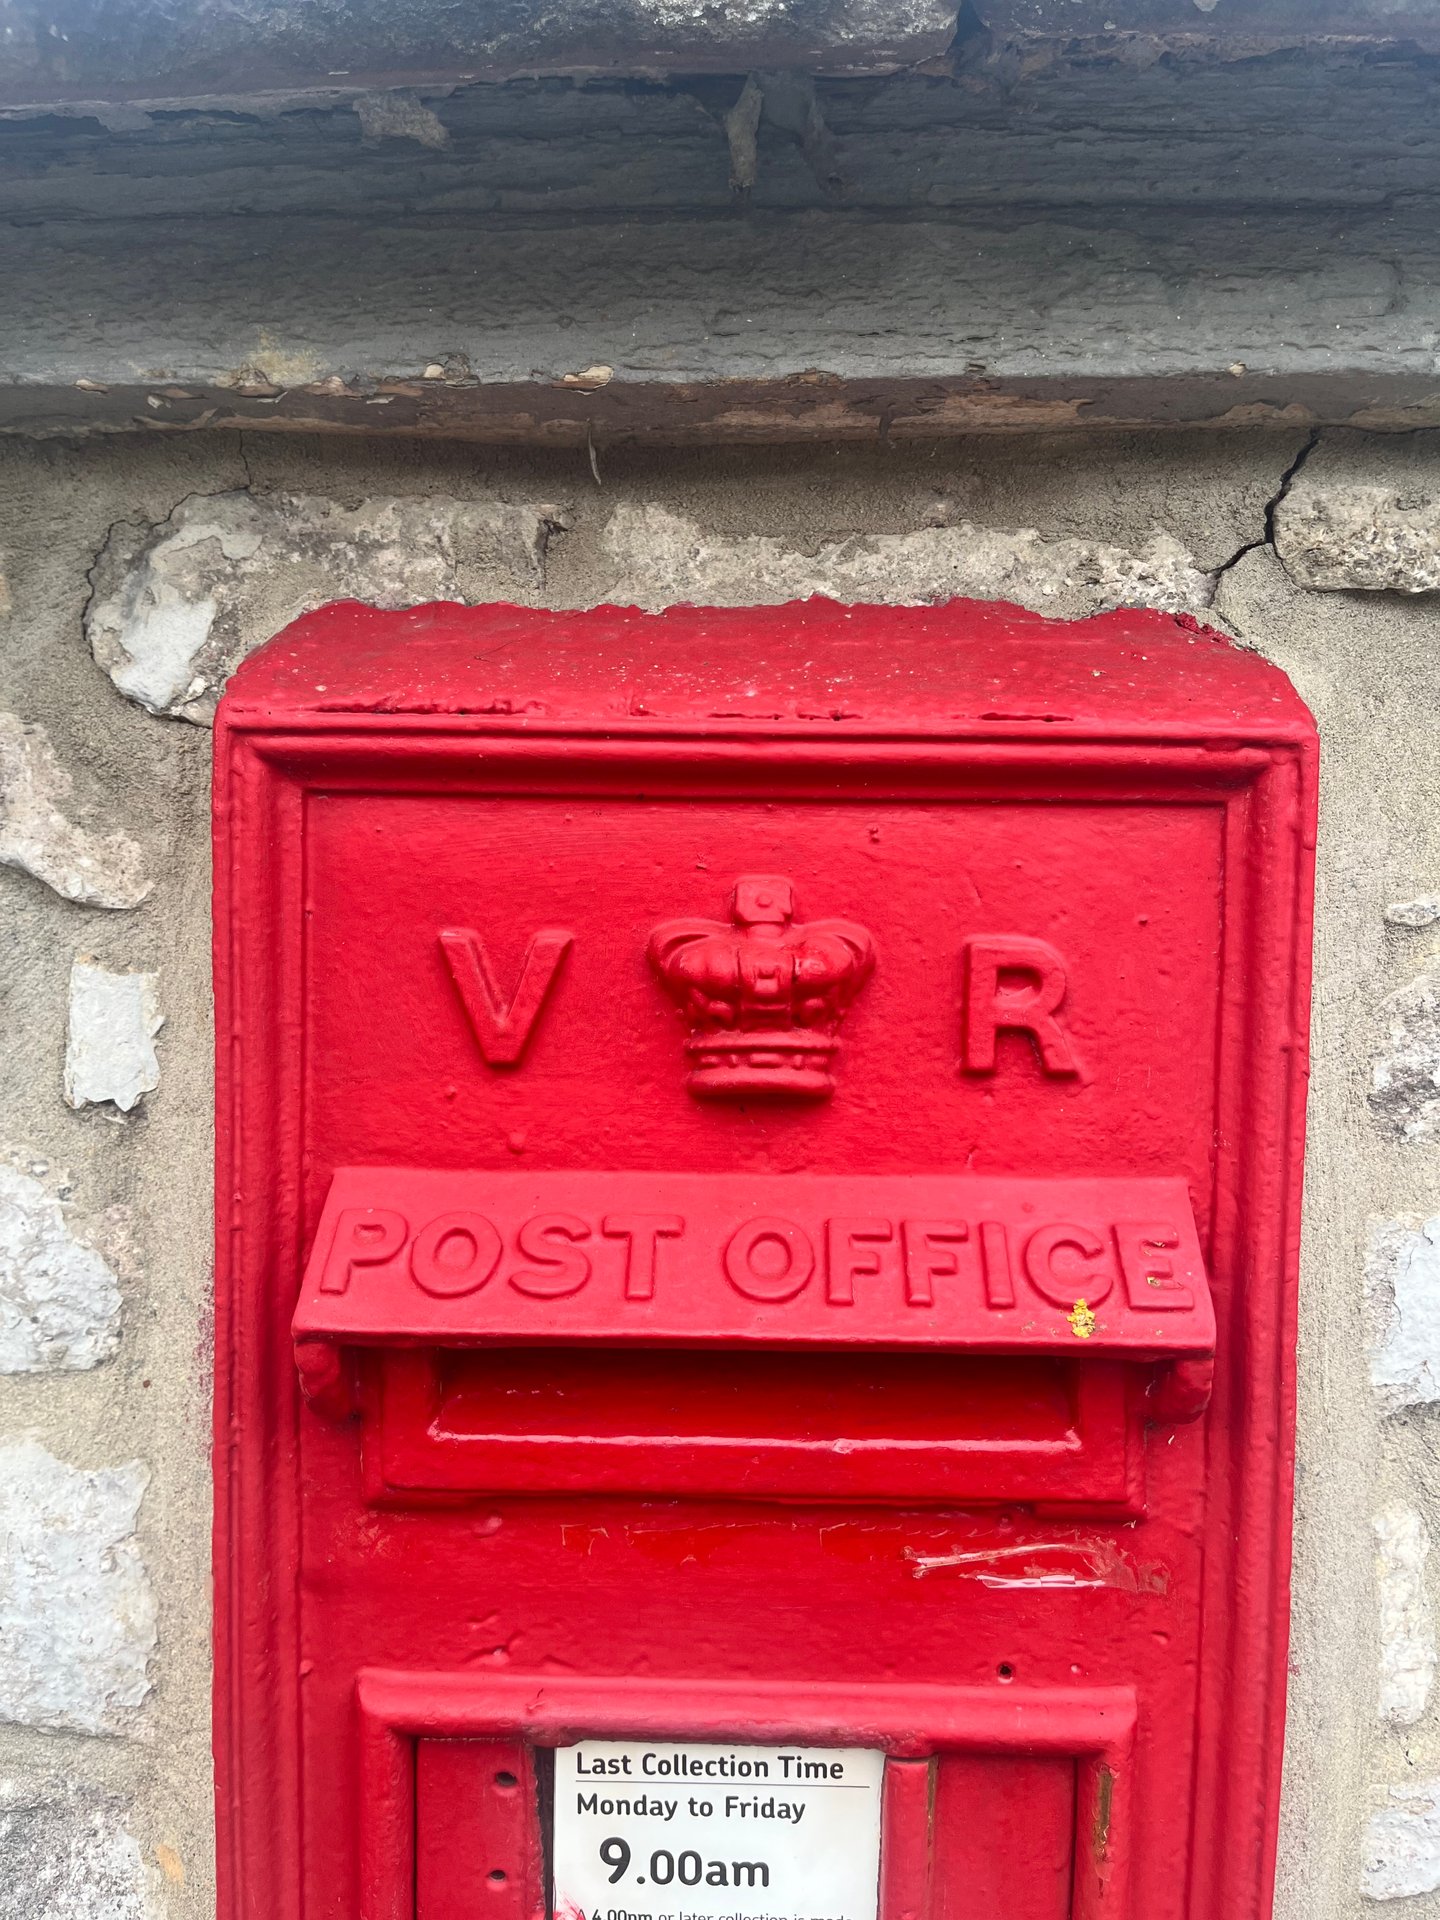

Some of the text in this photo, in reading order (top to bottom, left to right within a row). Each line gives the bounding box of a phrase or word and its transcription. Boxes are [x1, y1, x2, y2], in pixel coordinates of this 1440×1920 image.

[437, 928, 1086, 1080] V R
[318, 1207, 1196, 1312] POST OFFICE
[576, 1752, 844, 1779] Last Collection Time
[576, 1793, 806, 1824] Monday to Friday
[599, 1836, 770, 1887] 9.00am
